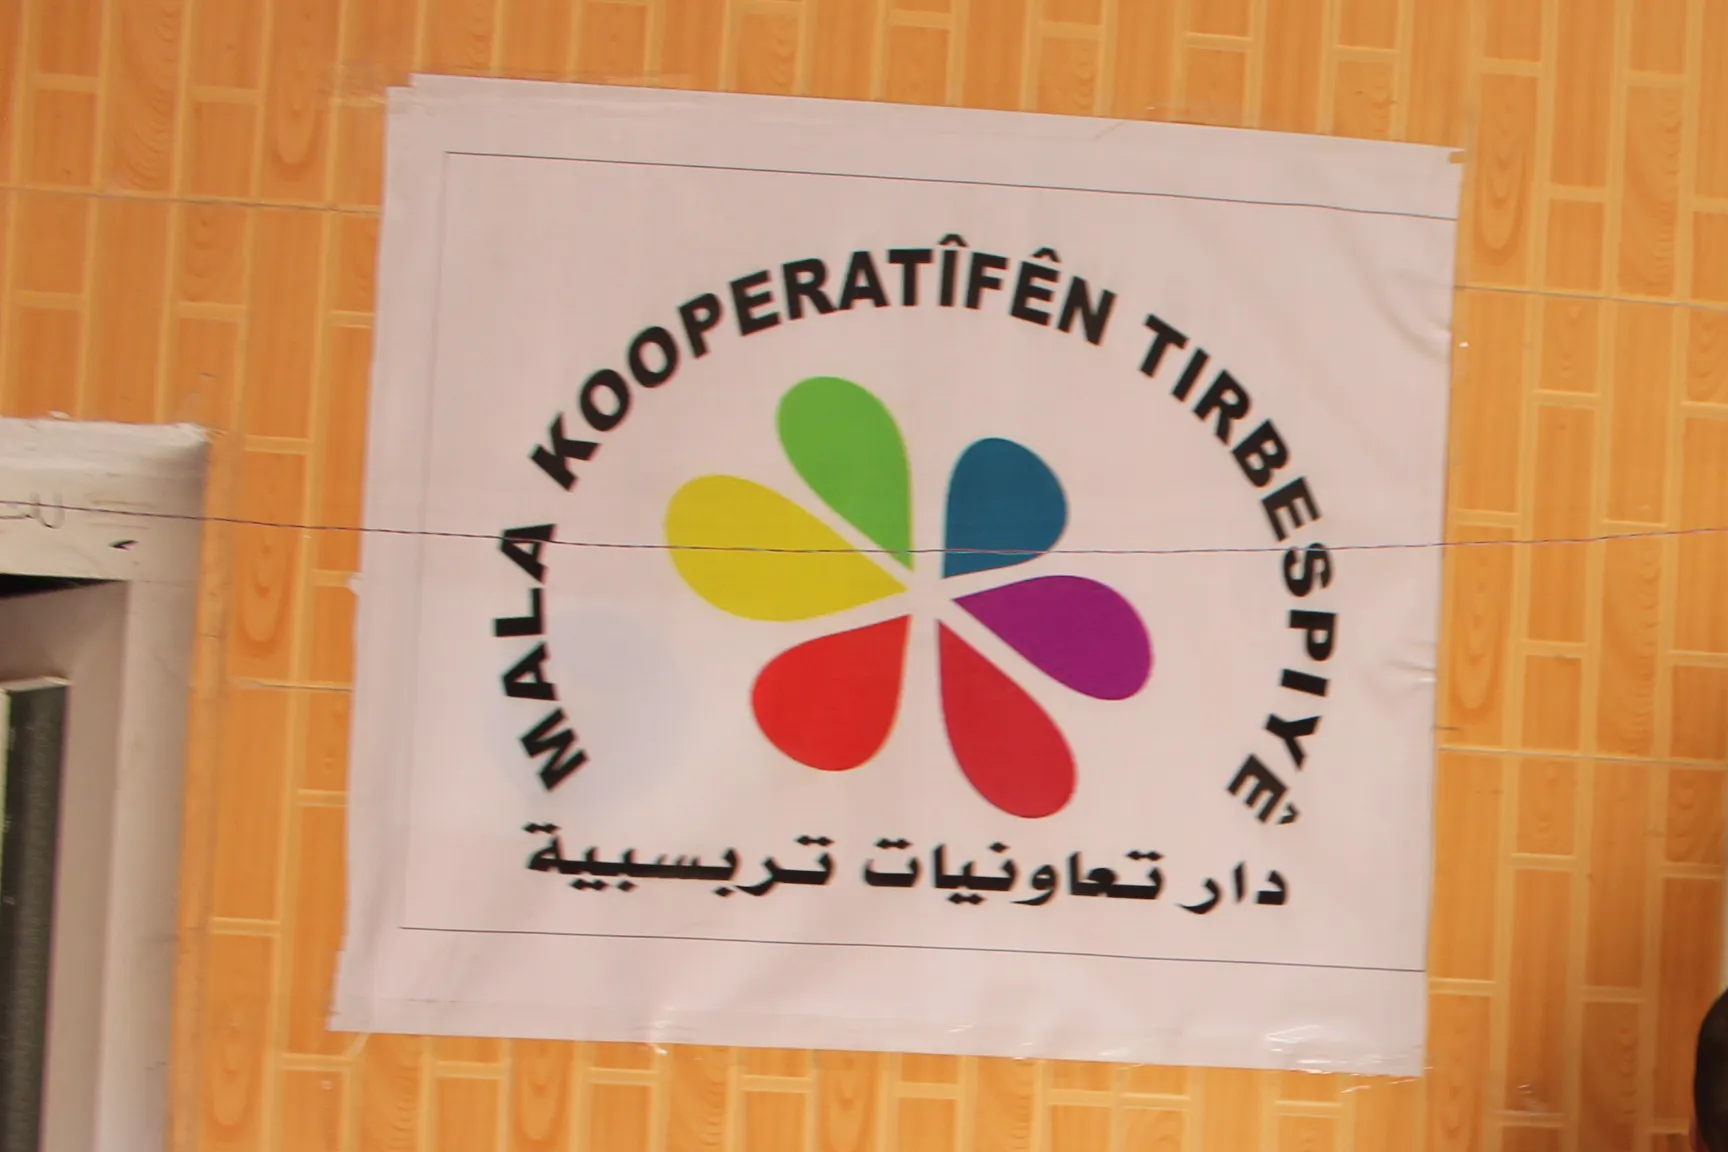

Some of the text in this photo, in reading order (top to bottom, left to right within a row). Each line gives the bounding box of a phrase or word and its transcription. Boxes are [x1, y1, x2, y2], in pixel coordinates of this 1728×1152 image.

[491, 233, 1338, 826] MALA KOOPERATÎFÊN TIRBESPIYÊ
[523, 823, 1289, 915] دار تعاونيات تربسبية
